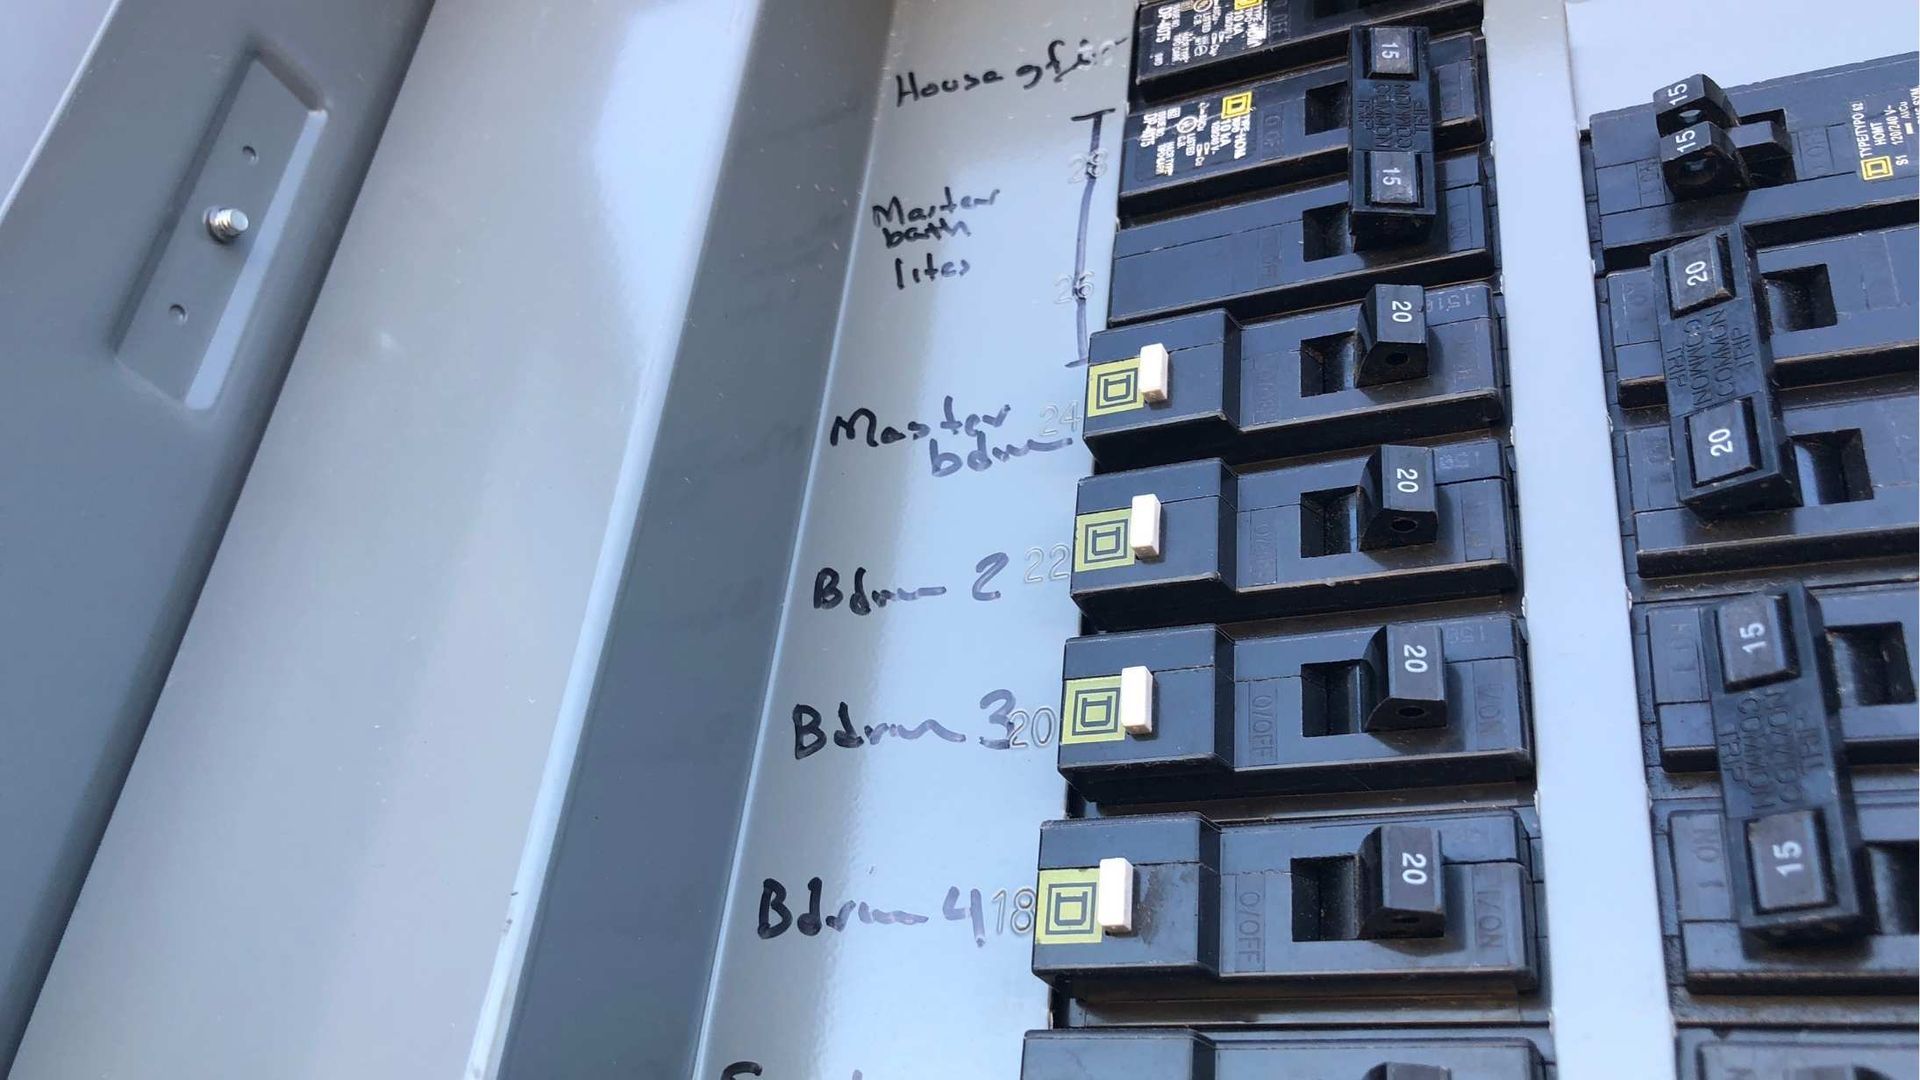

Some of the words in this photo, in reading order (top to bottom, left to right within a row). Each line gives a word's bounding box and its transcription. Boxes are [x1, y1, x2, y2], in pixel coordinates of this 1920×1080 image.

[1381, 42, 1400, 59] 15
[895, 70, 1004, 108] House
[1668, 83, 1688, 106] 15
[1675, 129, 1697, 153] 15
[1869, 121, 1887, 146] HOMT
[1885, 115, 1904, 146] 120/240
[1382, 167, 1402, 186] 15
[872, 186, 1000, 229] Master
[883, 217, 971, 250] bath
[895, 252, 971, 291] lites
[1685, 260, 1709, 287] 20
[1391, 299, 1413, 323] 20
[1683, 318, 1710, 409] COMMON
[1706, 308, 1737, 397] COMMON
[1731, 327, 1754, 369] TRIP
[1667, 347, 1689, 388] TRIP
[829, 395, 1012, 448] Master
[1039, 401, 1081, 437] 24
[1708, 428, 1733, 457] 20
[1396, 468, 1419, 493] 20
[971, 552, 1010, 601] 2
[1023, 543, 1070, 584] 22
[1739, 622, 1766, 654] 15
[1403, 644, 1429, 673] 20
[979, 688, 1017, 750] 3
[1010, 706, 1056, 748] 20
[1402, 853, 1427, 885] 20
[1772, 840, 1804, 878] 15
[942, 885, 987, 948] 4
[992, 887, 1038, 937] 18
[1238, 890, 1261, 965] O/OFF
